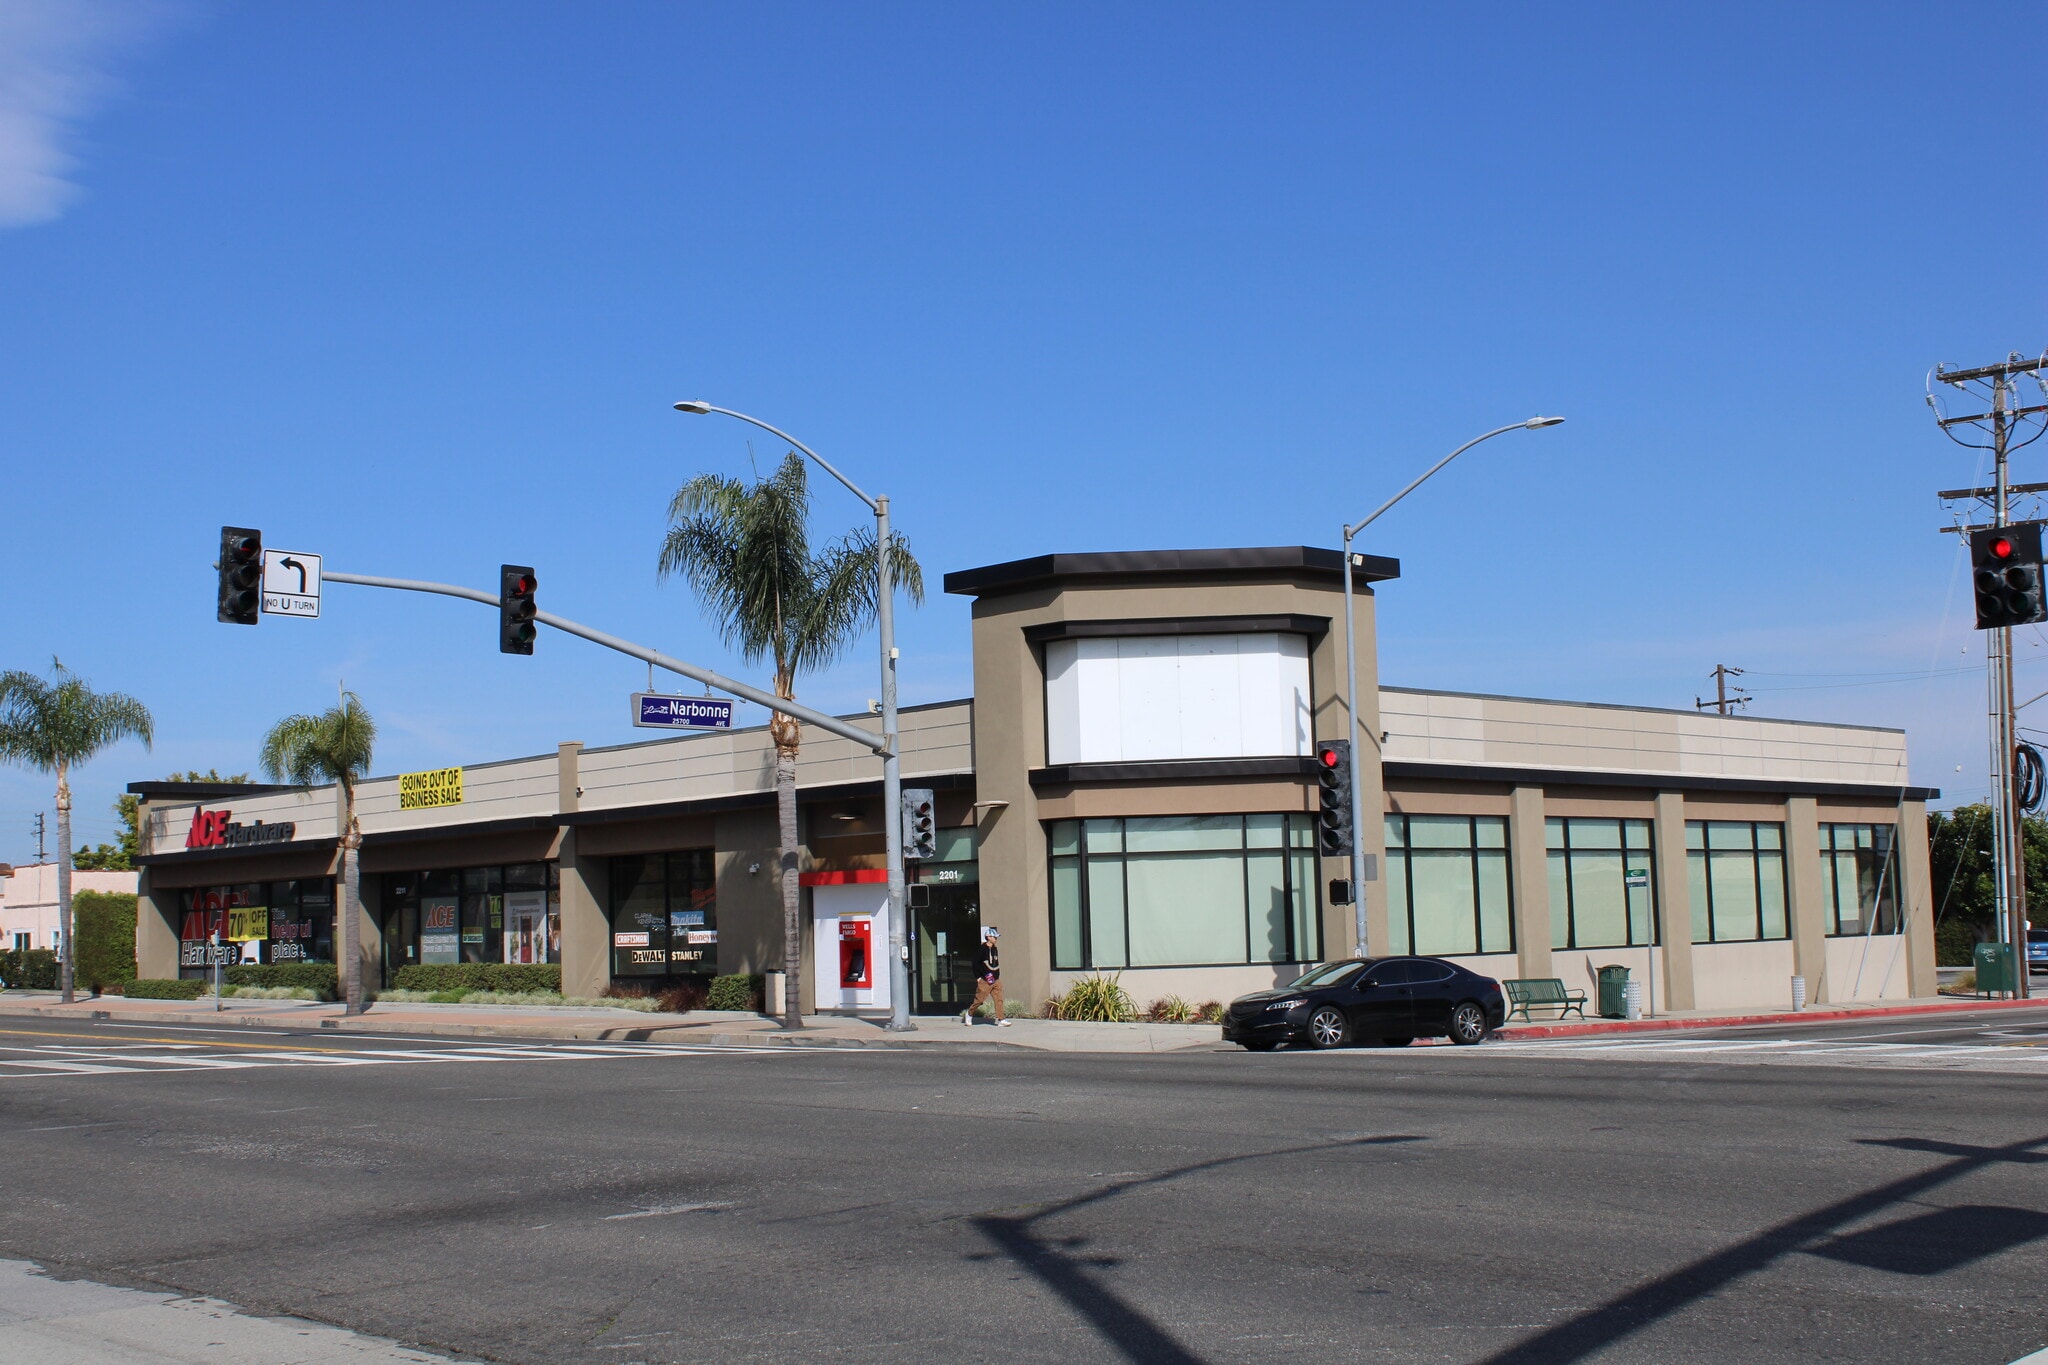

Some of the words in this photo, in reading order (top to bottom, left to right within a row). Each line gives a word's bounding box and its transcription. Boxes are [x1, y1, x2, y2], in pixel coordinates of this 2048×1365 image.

[266, 598, 278, 607] NO
[282, 598, 290, 610] U
[294, 601, 315, 611] TURN
[670, 701, 729, 718] Narbonne
[672, 717, 690, 725] 25700
[402, 774, 427, 790] GOING
[429, 771, 446, 788] OUT
[448, 769, 459, 786] OF
[401, 790, 439, 808] BUSINESS
[441, 787, 461, 804] SALE
[185, 805, 231, 848] ACE
[227, 819, 294, 843] Hardware
[939, 870, 958, 880] 2201
[251, 910, 266, 923] OFF
[425, 904, 456, 928] ACE
[251, 926, 266, 936] SALE
[271, 919, 312, 942] helpul
[671, 951, 703, 960] STANLEY
